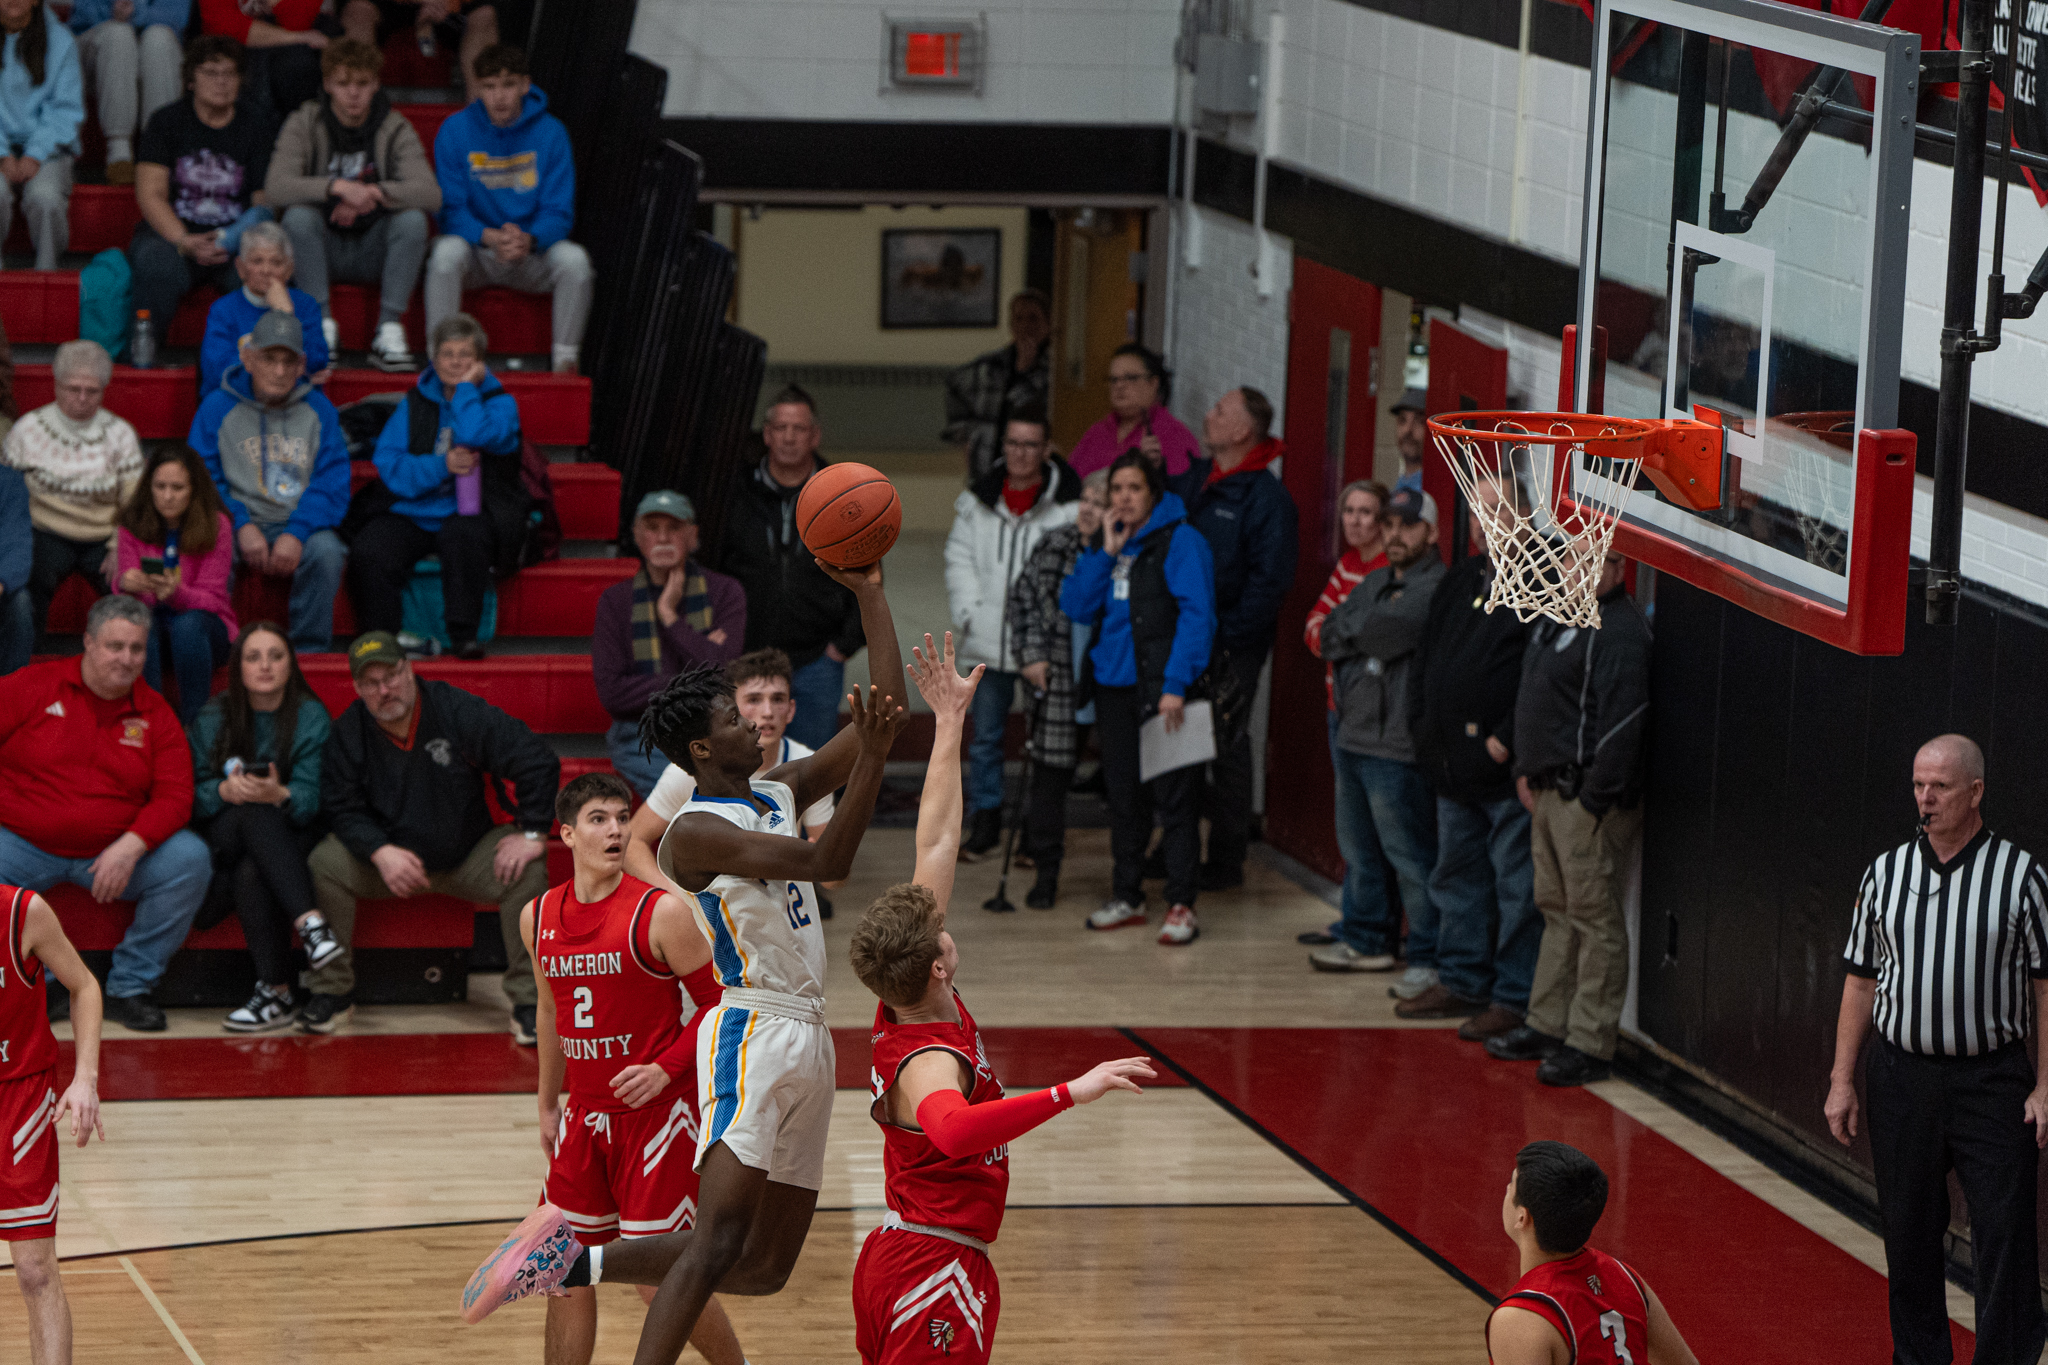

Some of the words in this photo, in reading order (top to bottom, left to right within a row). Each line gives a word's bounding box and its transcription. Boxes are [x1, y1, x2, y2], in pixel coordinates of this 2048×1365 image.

[787, 882, 812, 931] 12
[541, 951, 622, 978] CAMERON
[573, 986, 594, 1029] 2
[560, 1033, 633, 1060] OUNTY
